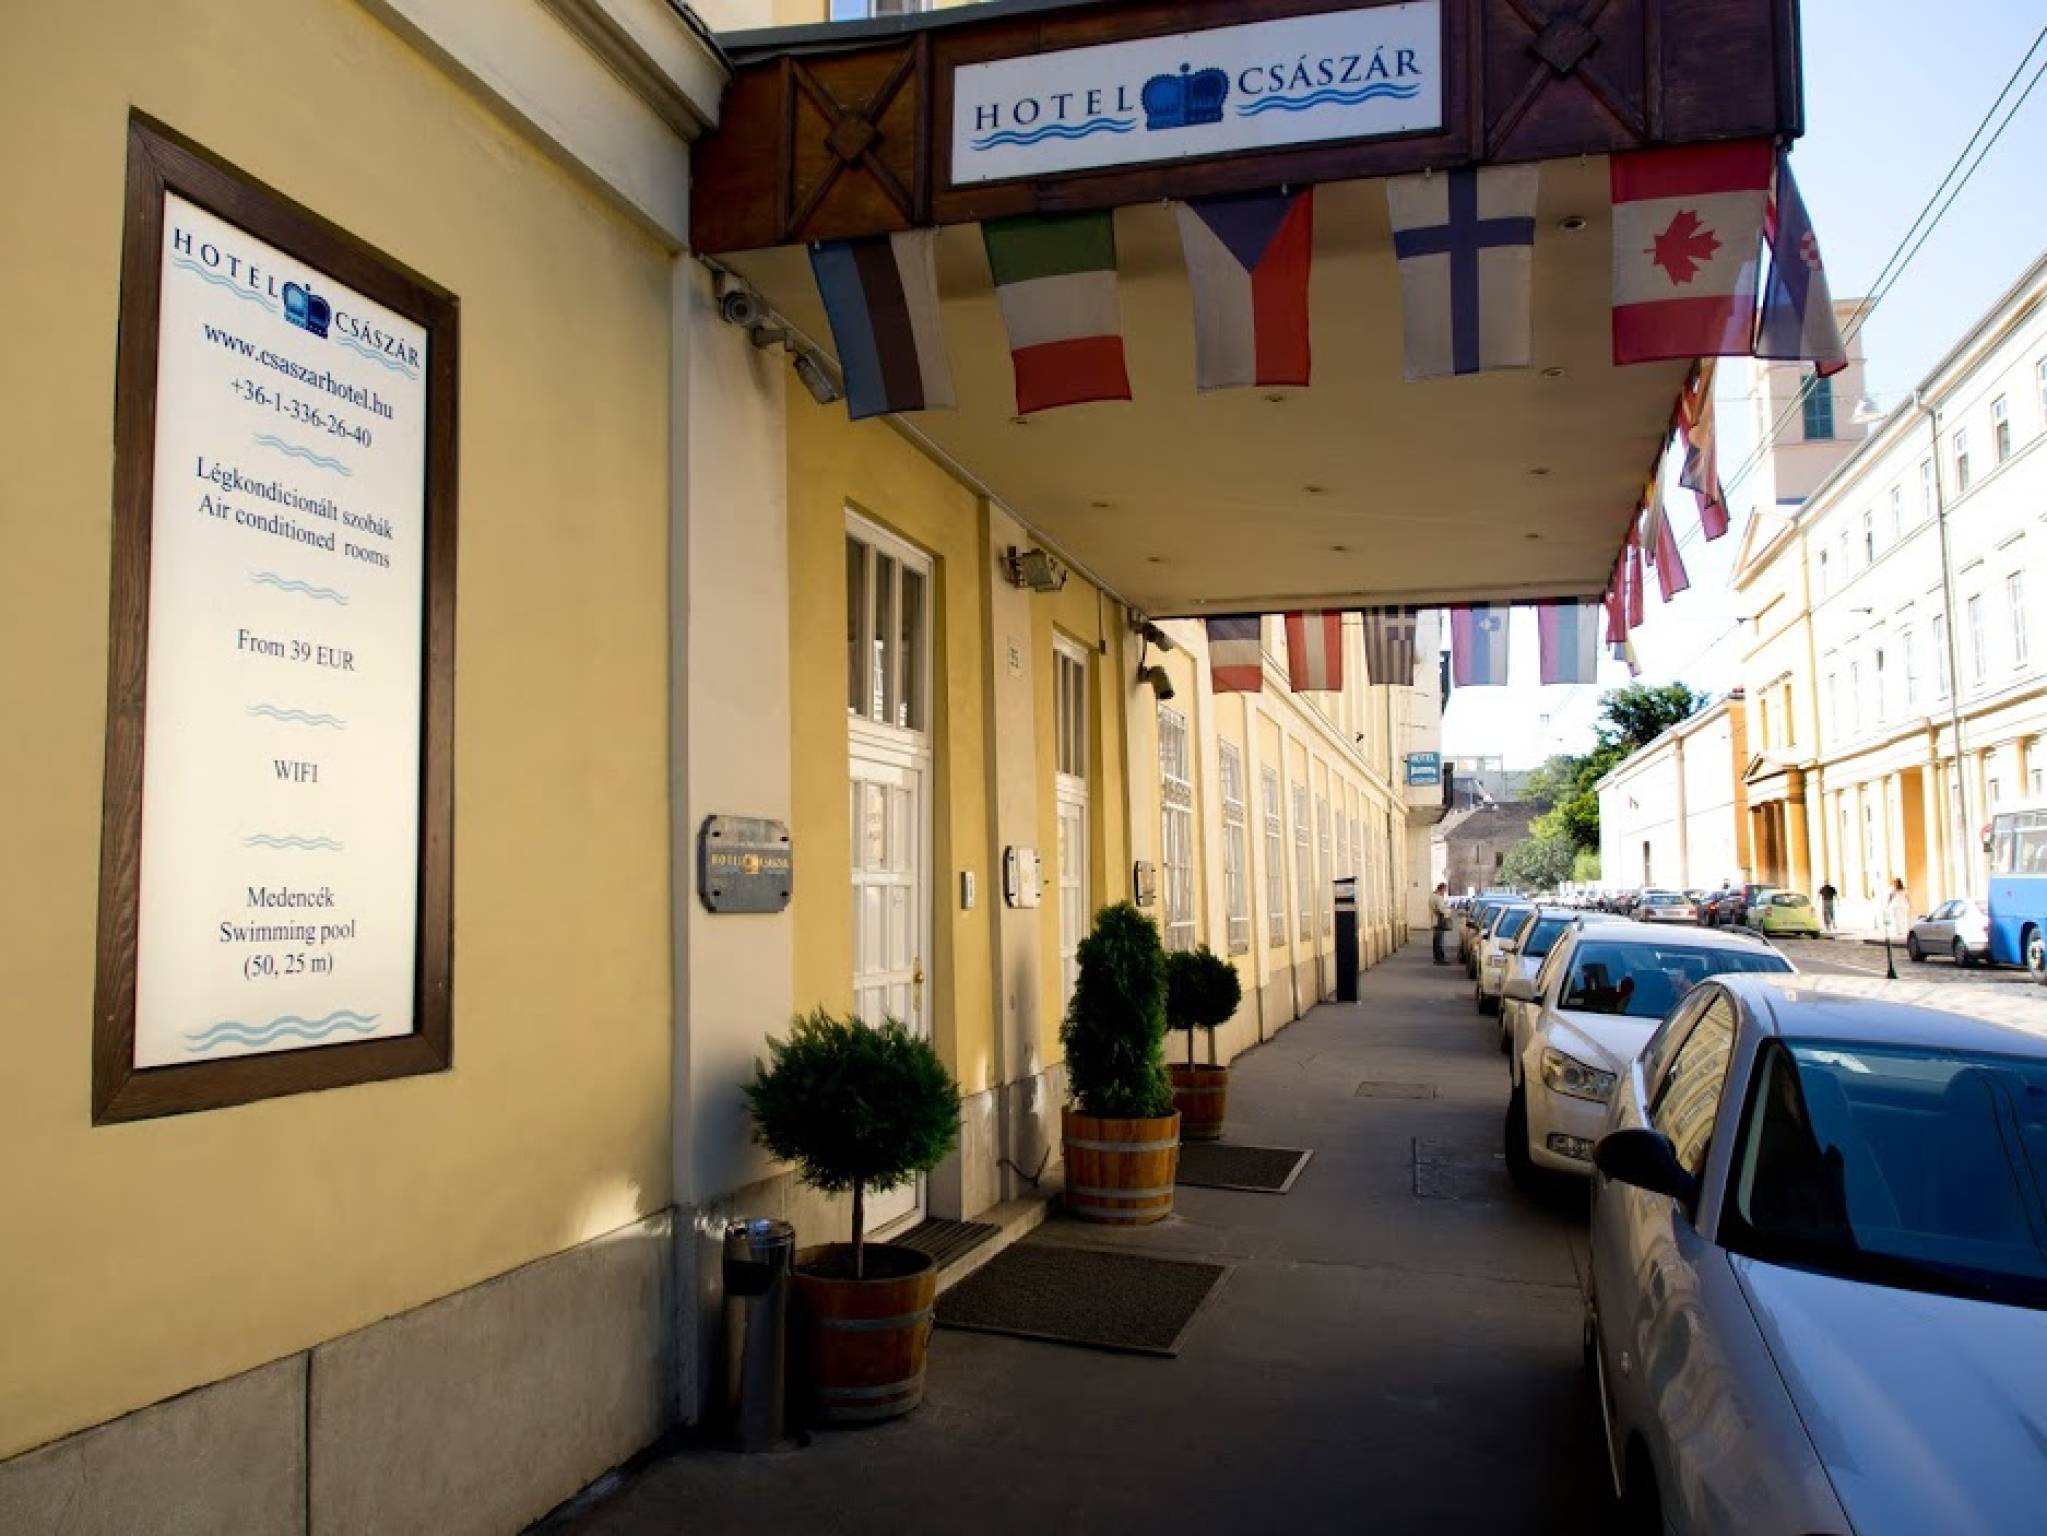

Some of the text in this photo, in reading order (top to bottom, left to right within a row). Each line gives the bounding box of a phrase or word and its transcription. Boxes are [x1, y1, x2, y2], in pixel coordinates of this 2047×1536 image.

[975, 45, 1422, 131] HOTEL CSÁSZÁR
[174, 227, 421, 369] HOTEL CSÁSZÁR
[204, 322, 393, 419] www.csaszarhotel.hu
[231, 377, 373, 449] +36-1-336-26-40
[196, 455, 393, 541] Légkondicionált szobák
[198, 493, 391, 569] Air conditioned rooms
[237, 628, 356, 672] From 39 EUR
[273, 758, 319, 784] WIFI
[219, 918, 356, 946] Swimming pool
[247, 886, 335, 909] Medencék
[243, 951, 334, 980] (50, 25 m)
